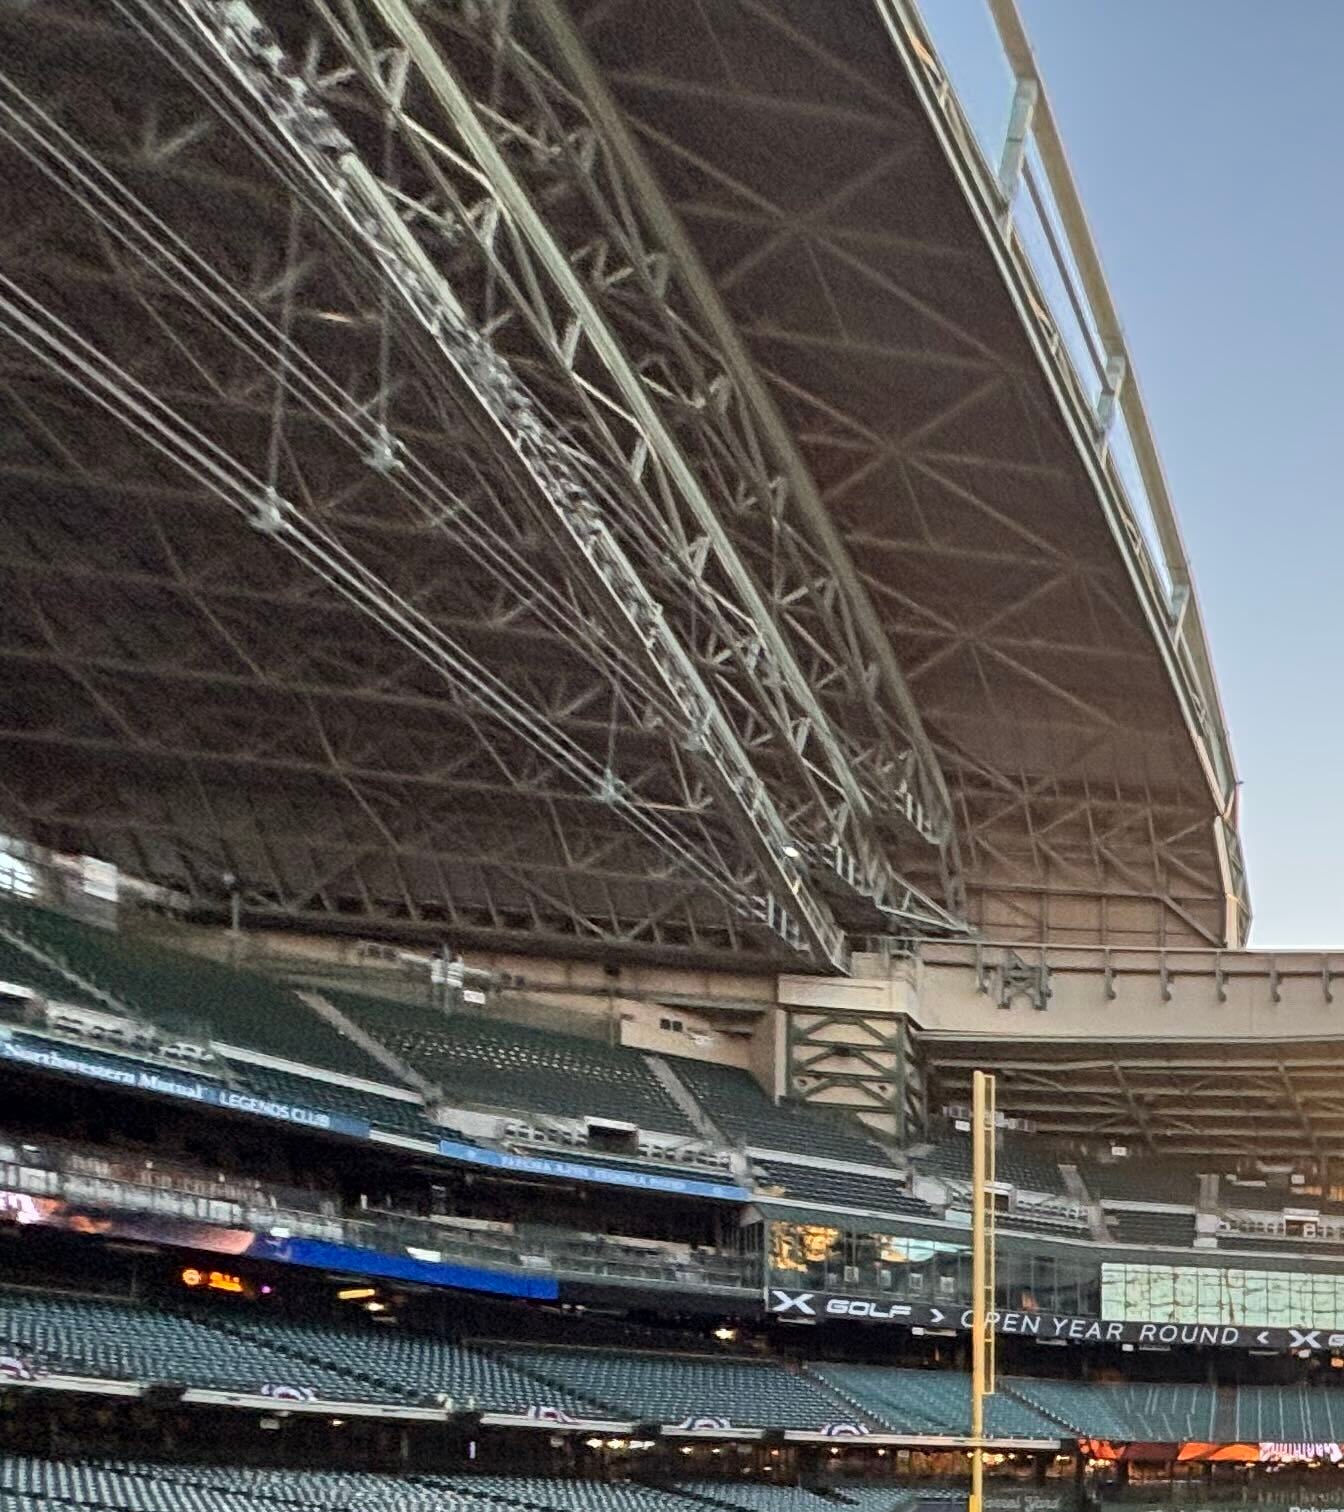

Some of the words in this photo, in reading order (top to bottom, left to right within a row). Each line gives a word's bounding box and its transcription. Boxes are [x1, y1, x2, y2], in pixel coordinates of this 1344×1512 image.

[219, 1092, 290, 1121] LEGENDS
[291, 1107, 331, 1128] CLUB
[826, 1299, 912, 1319] GOLF
[960, 1308, 1041, 1333] OPEN
[1053, 1316, 1124, 1341] YEAR
[1139, 1324, 1240, 1345] ROUND
